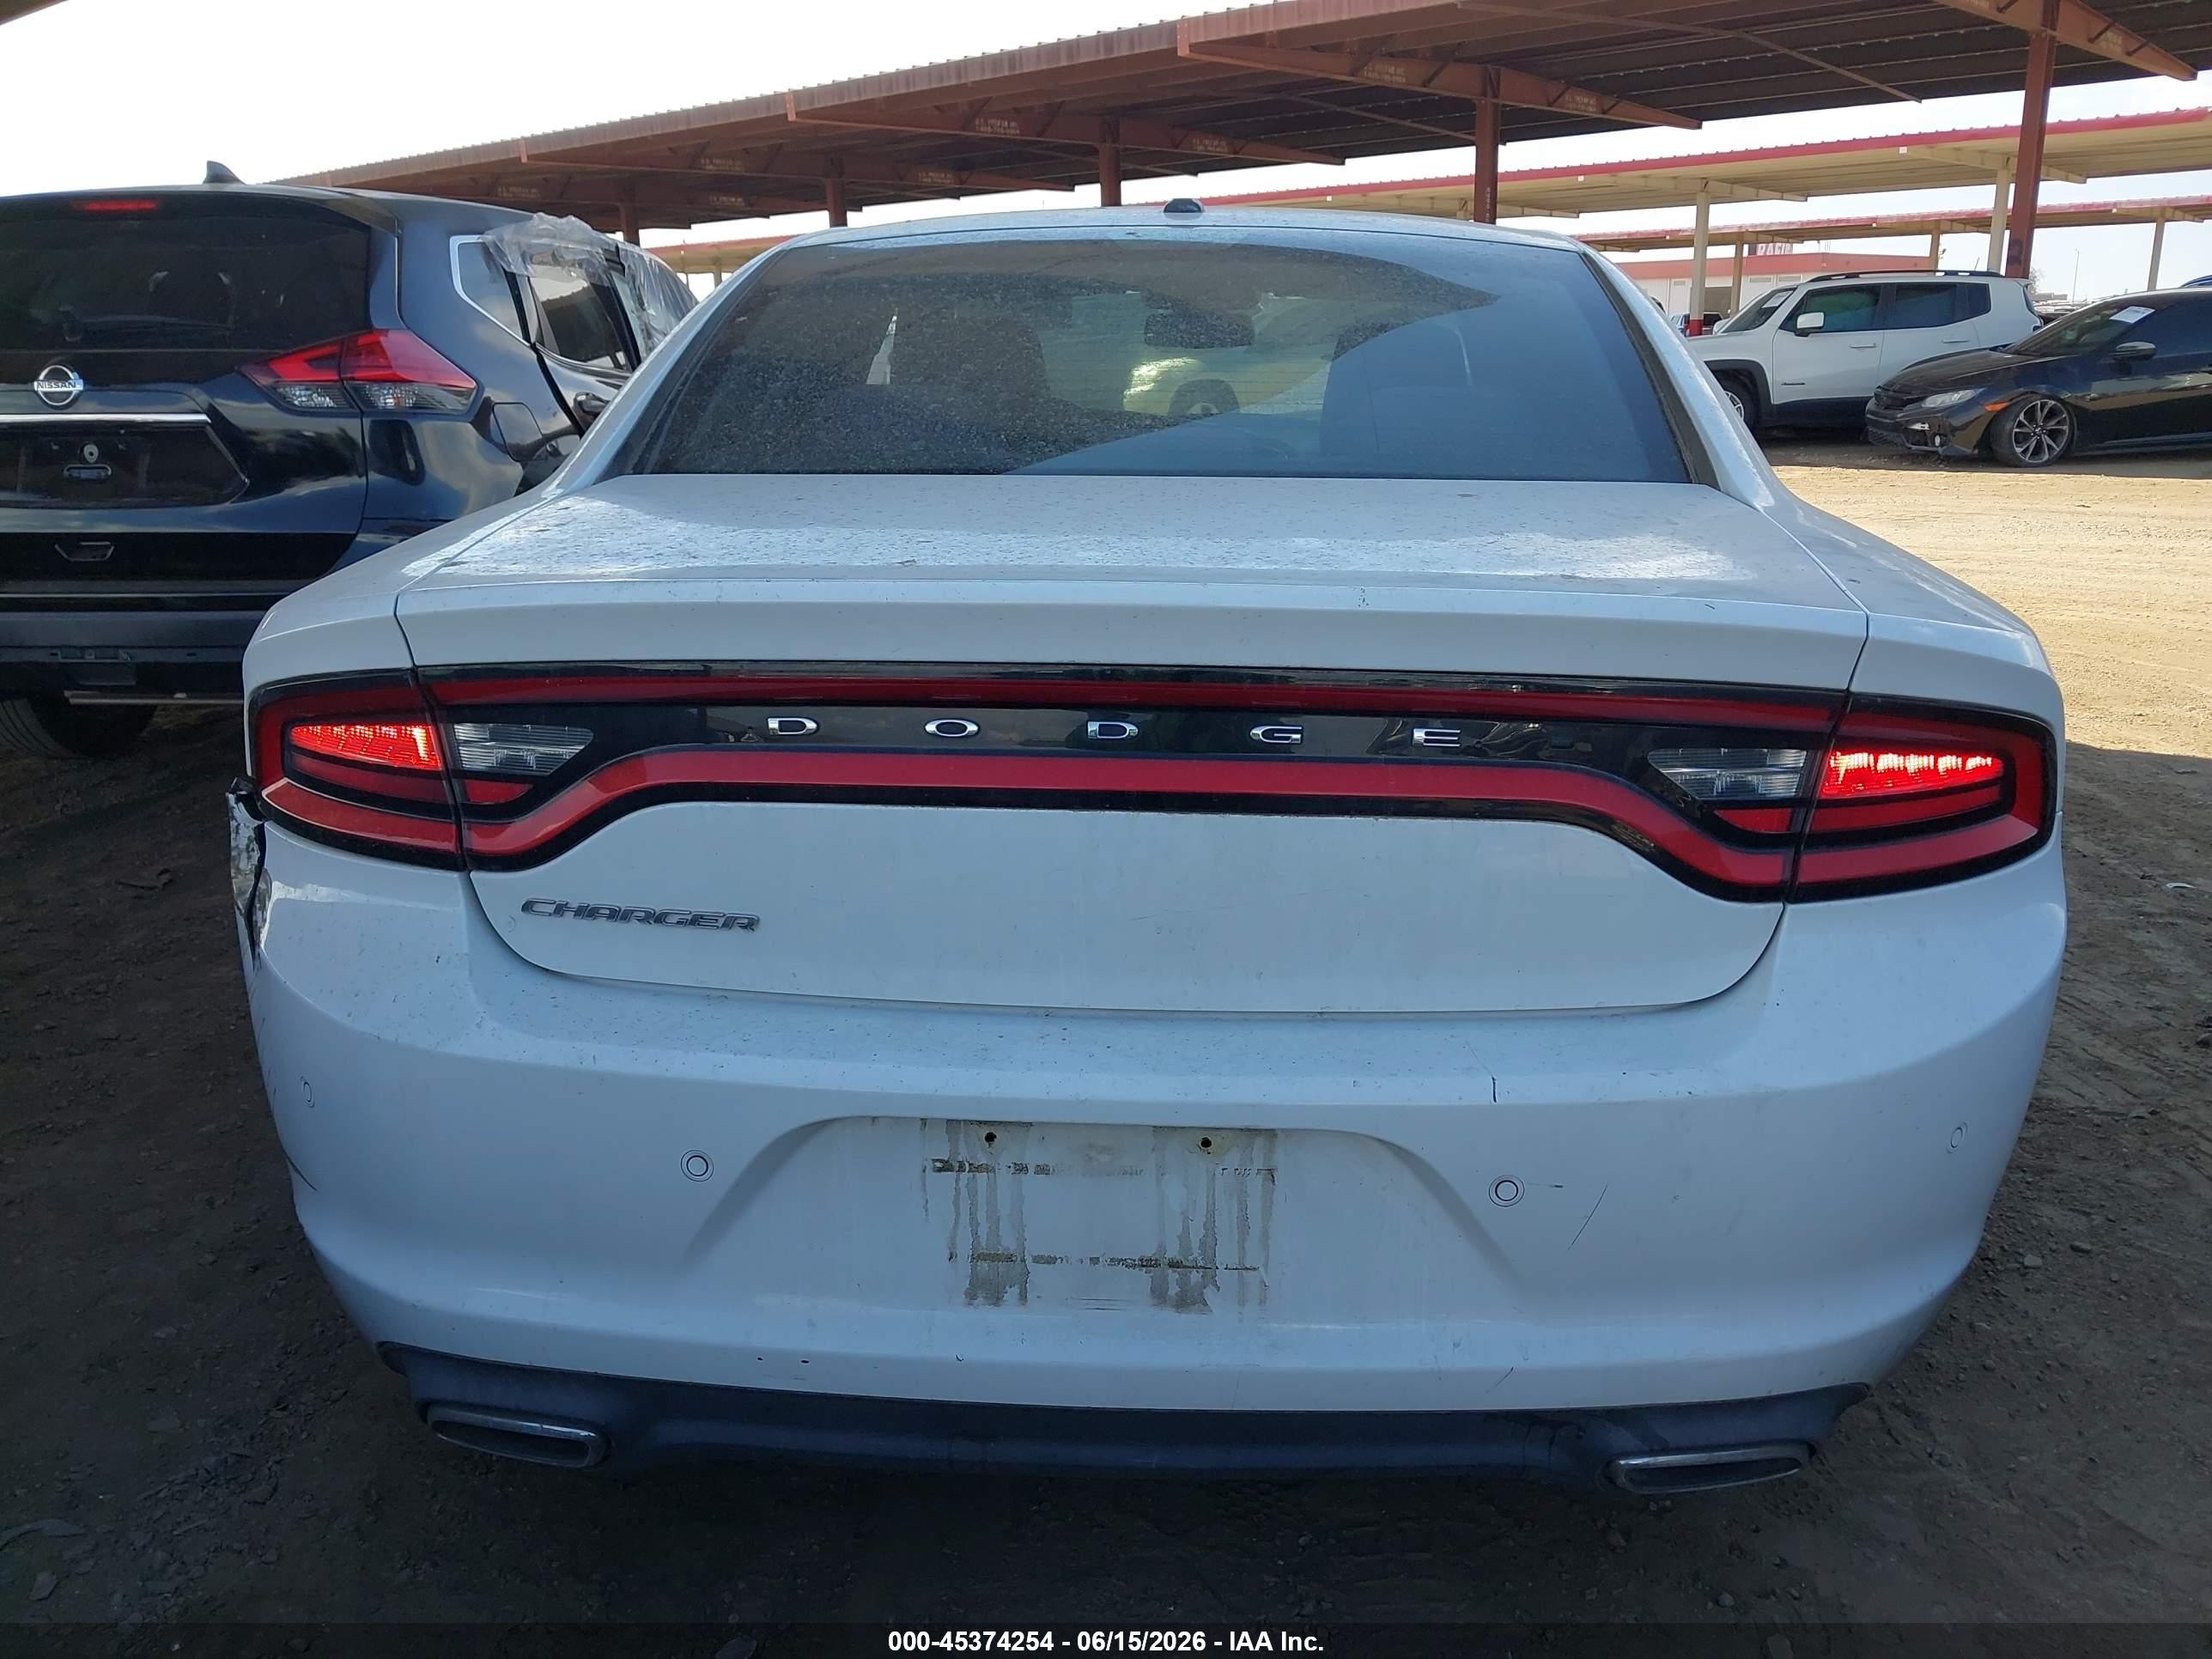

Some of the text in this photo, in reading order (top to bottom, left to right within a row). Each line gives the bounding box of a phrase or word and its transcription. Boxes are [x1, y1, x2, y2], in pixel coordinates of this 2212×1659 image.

[36, 380, 77, 390] NISSAN
[768, 718, 1461, 747] DODGE
[521, 897, 760, 932] CHARGER
